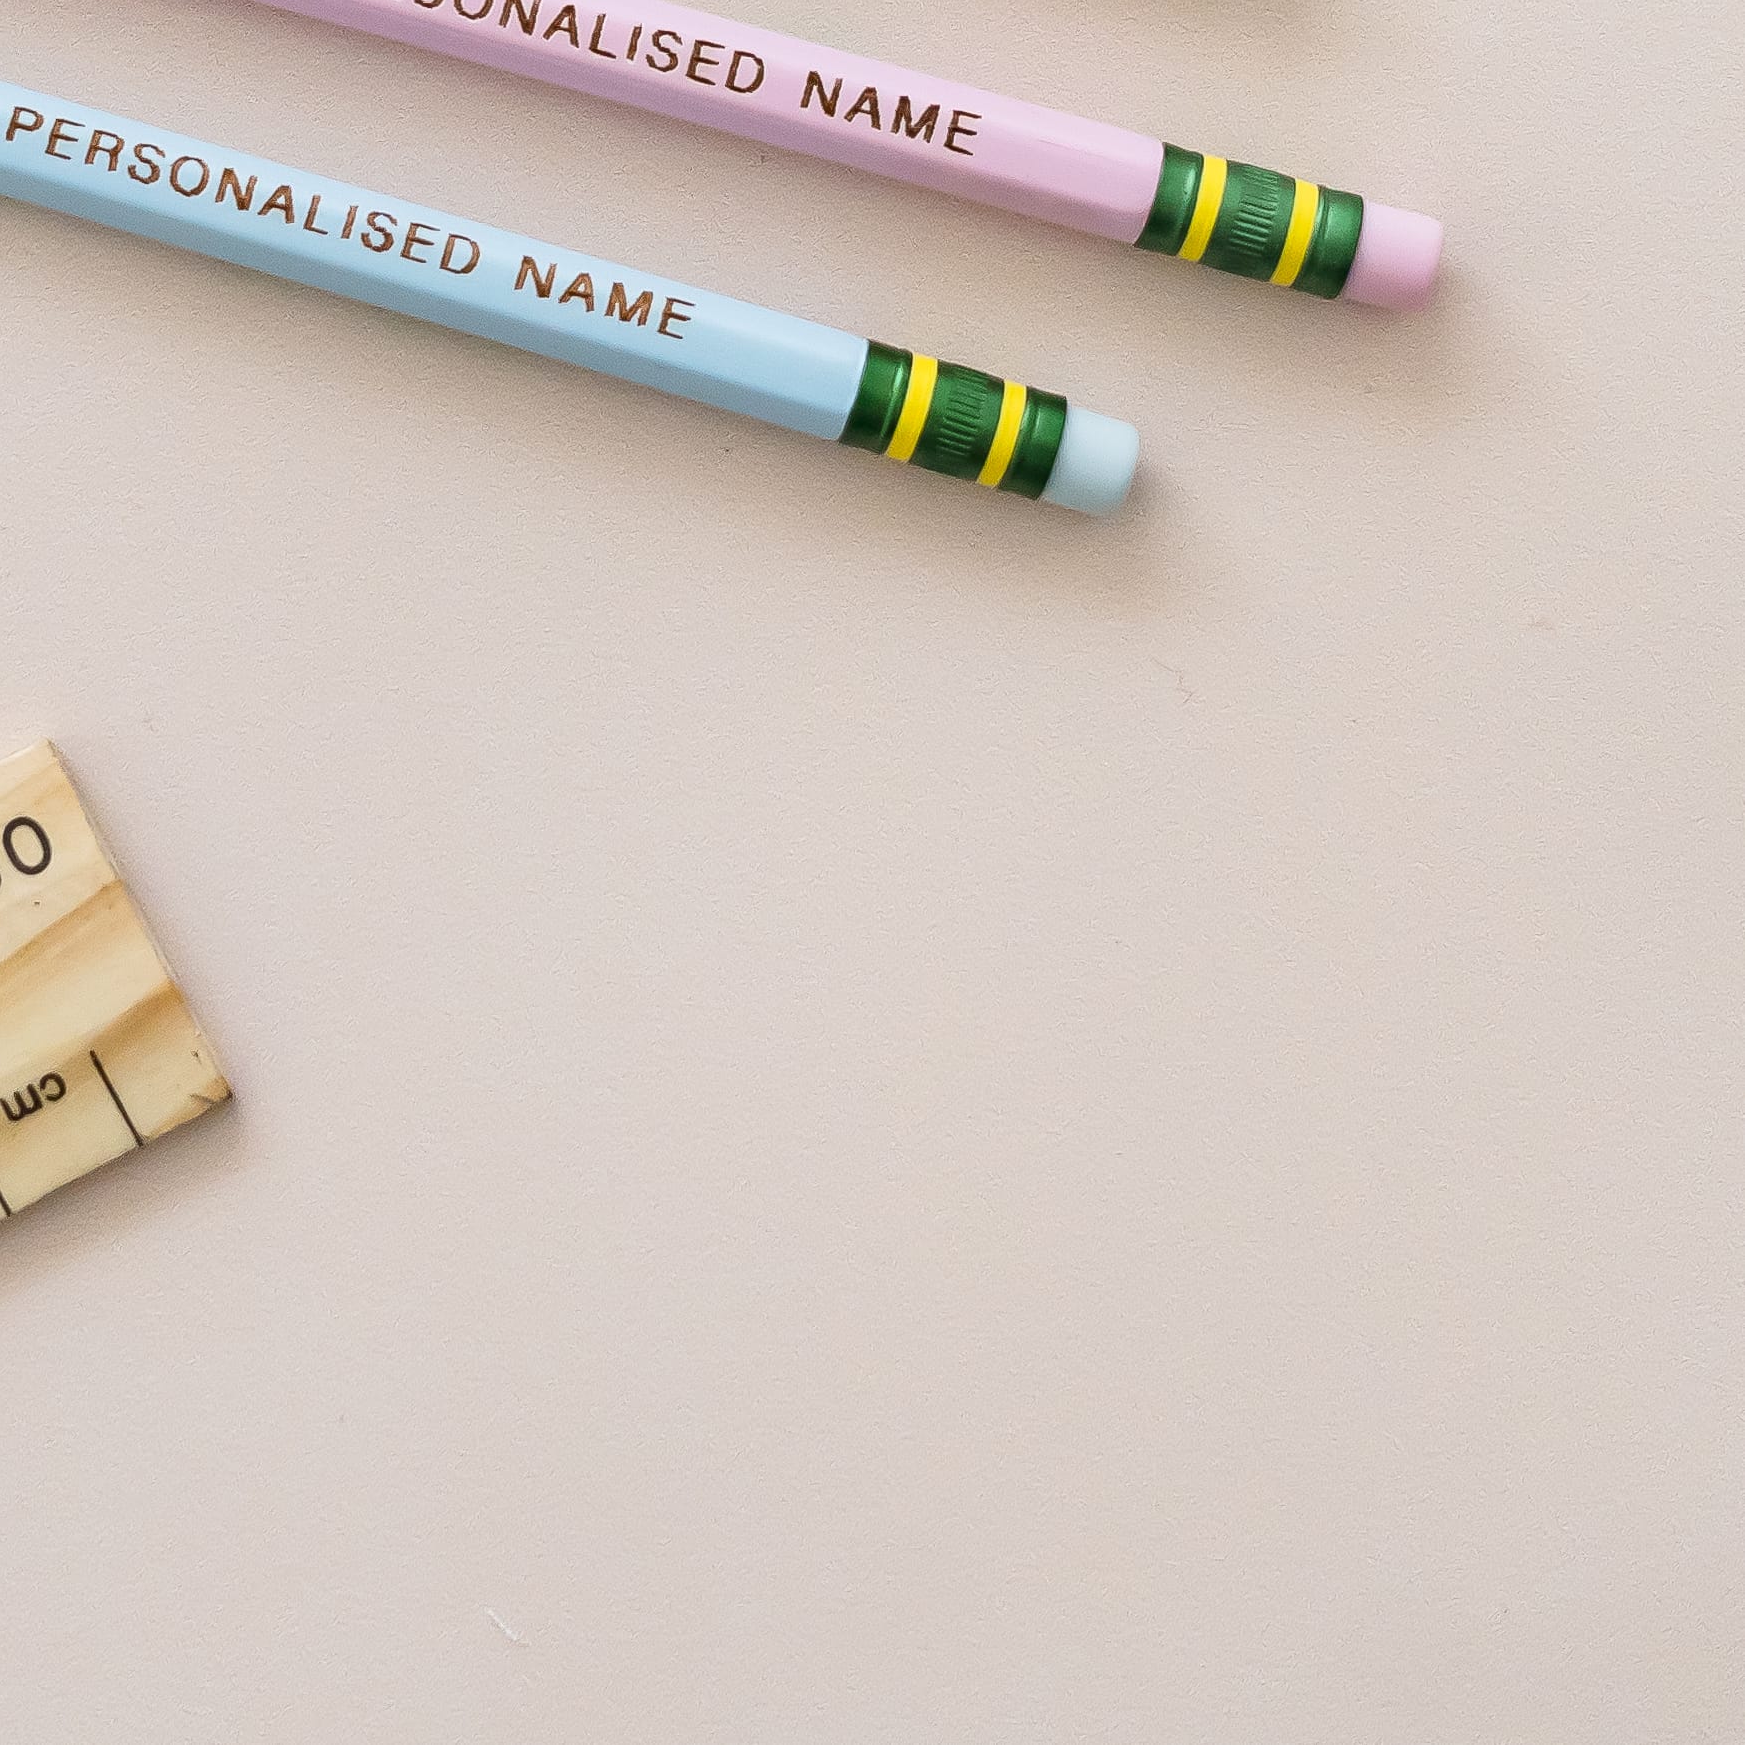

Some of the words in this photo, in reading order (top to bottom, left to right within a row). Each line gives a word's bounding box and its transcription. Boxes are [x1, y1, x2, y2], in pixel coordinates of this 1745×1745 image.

[800, 70, 982, 156] NAME
[5, 106, 481, 275] PERSONALISED
[514, 255, 696, 340] NAME
[0, 1072, 67, 1124] cm
